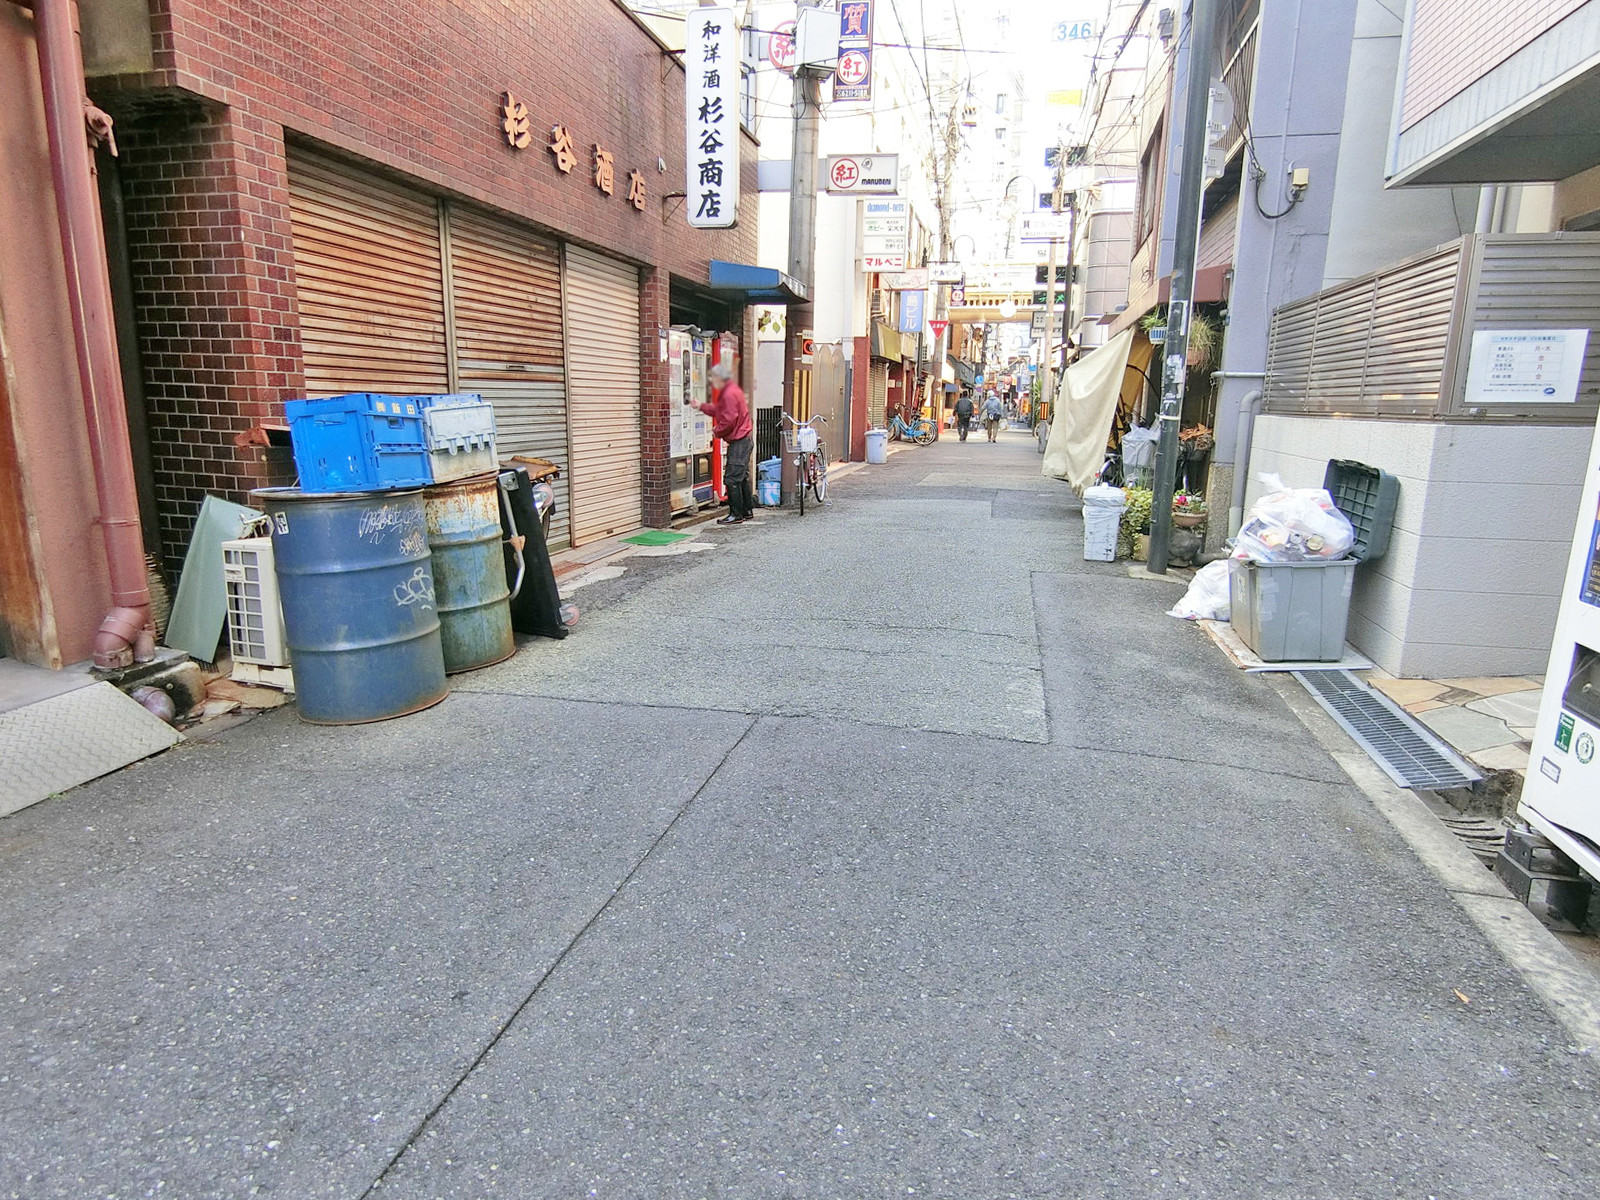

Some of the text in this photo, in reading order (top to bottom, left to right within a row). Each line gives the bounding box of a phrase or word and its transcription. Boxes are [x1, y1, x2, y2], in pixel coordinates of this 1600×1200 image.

[842, 4, 867, 35] 質
[1057, 22, 1092, 41] 346
[843, 57, 863, 78] 紅
[696, 20, 725, 219] 和洋酒 杉谷商店
[501, 90, 646, 212] 杉谷酒店
[835, 164, 856, 183] 紅
[865, 257, 902, 267] マルベニ
